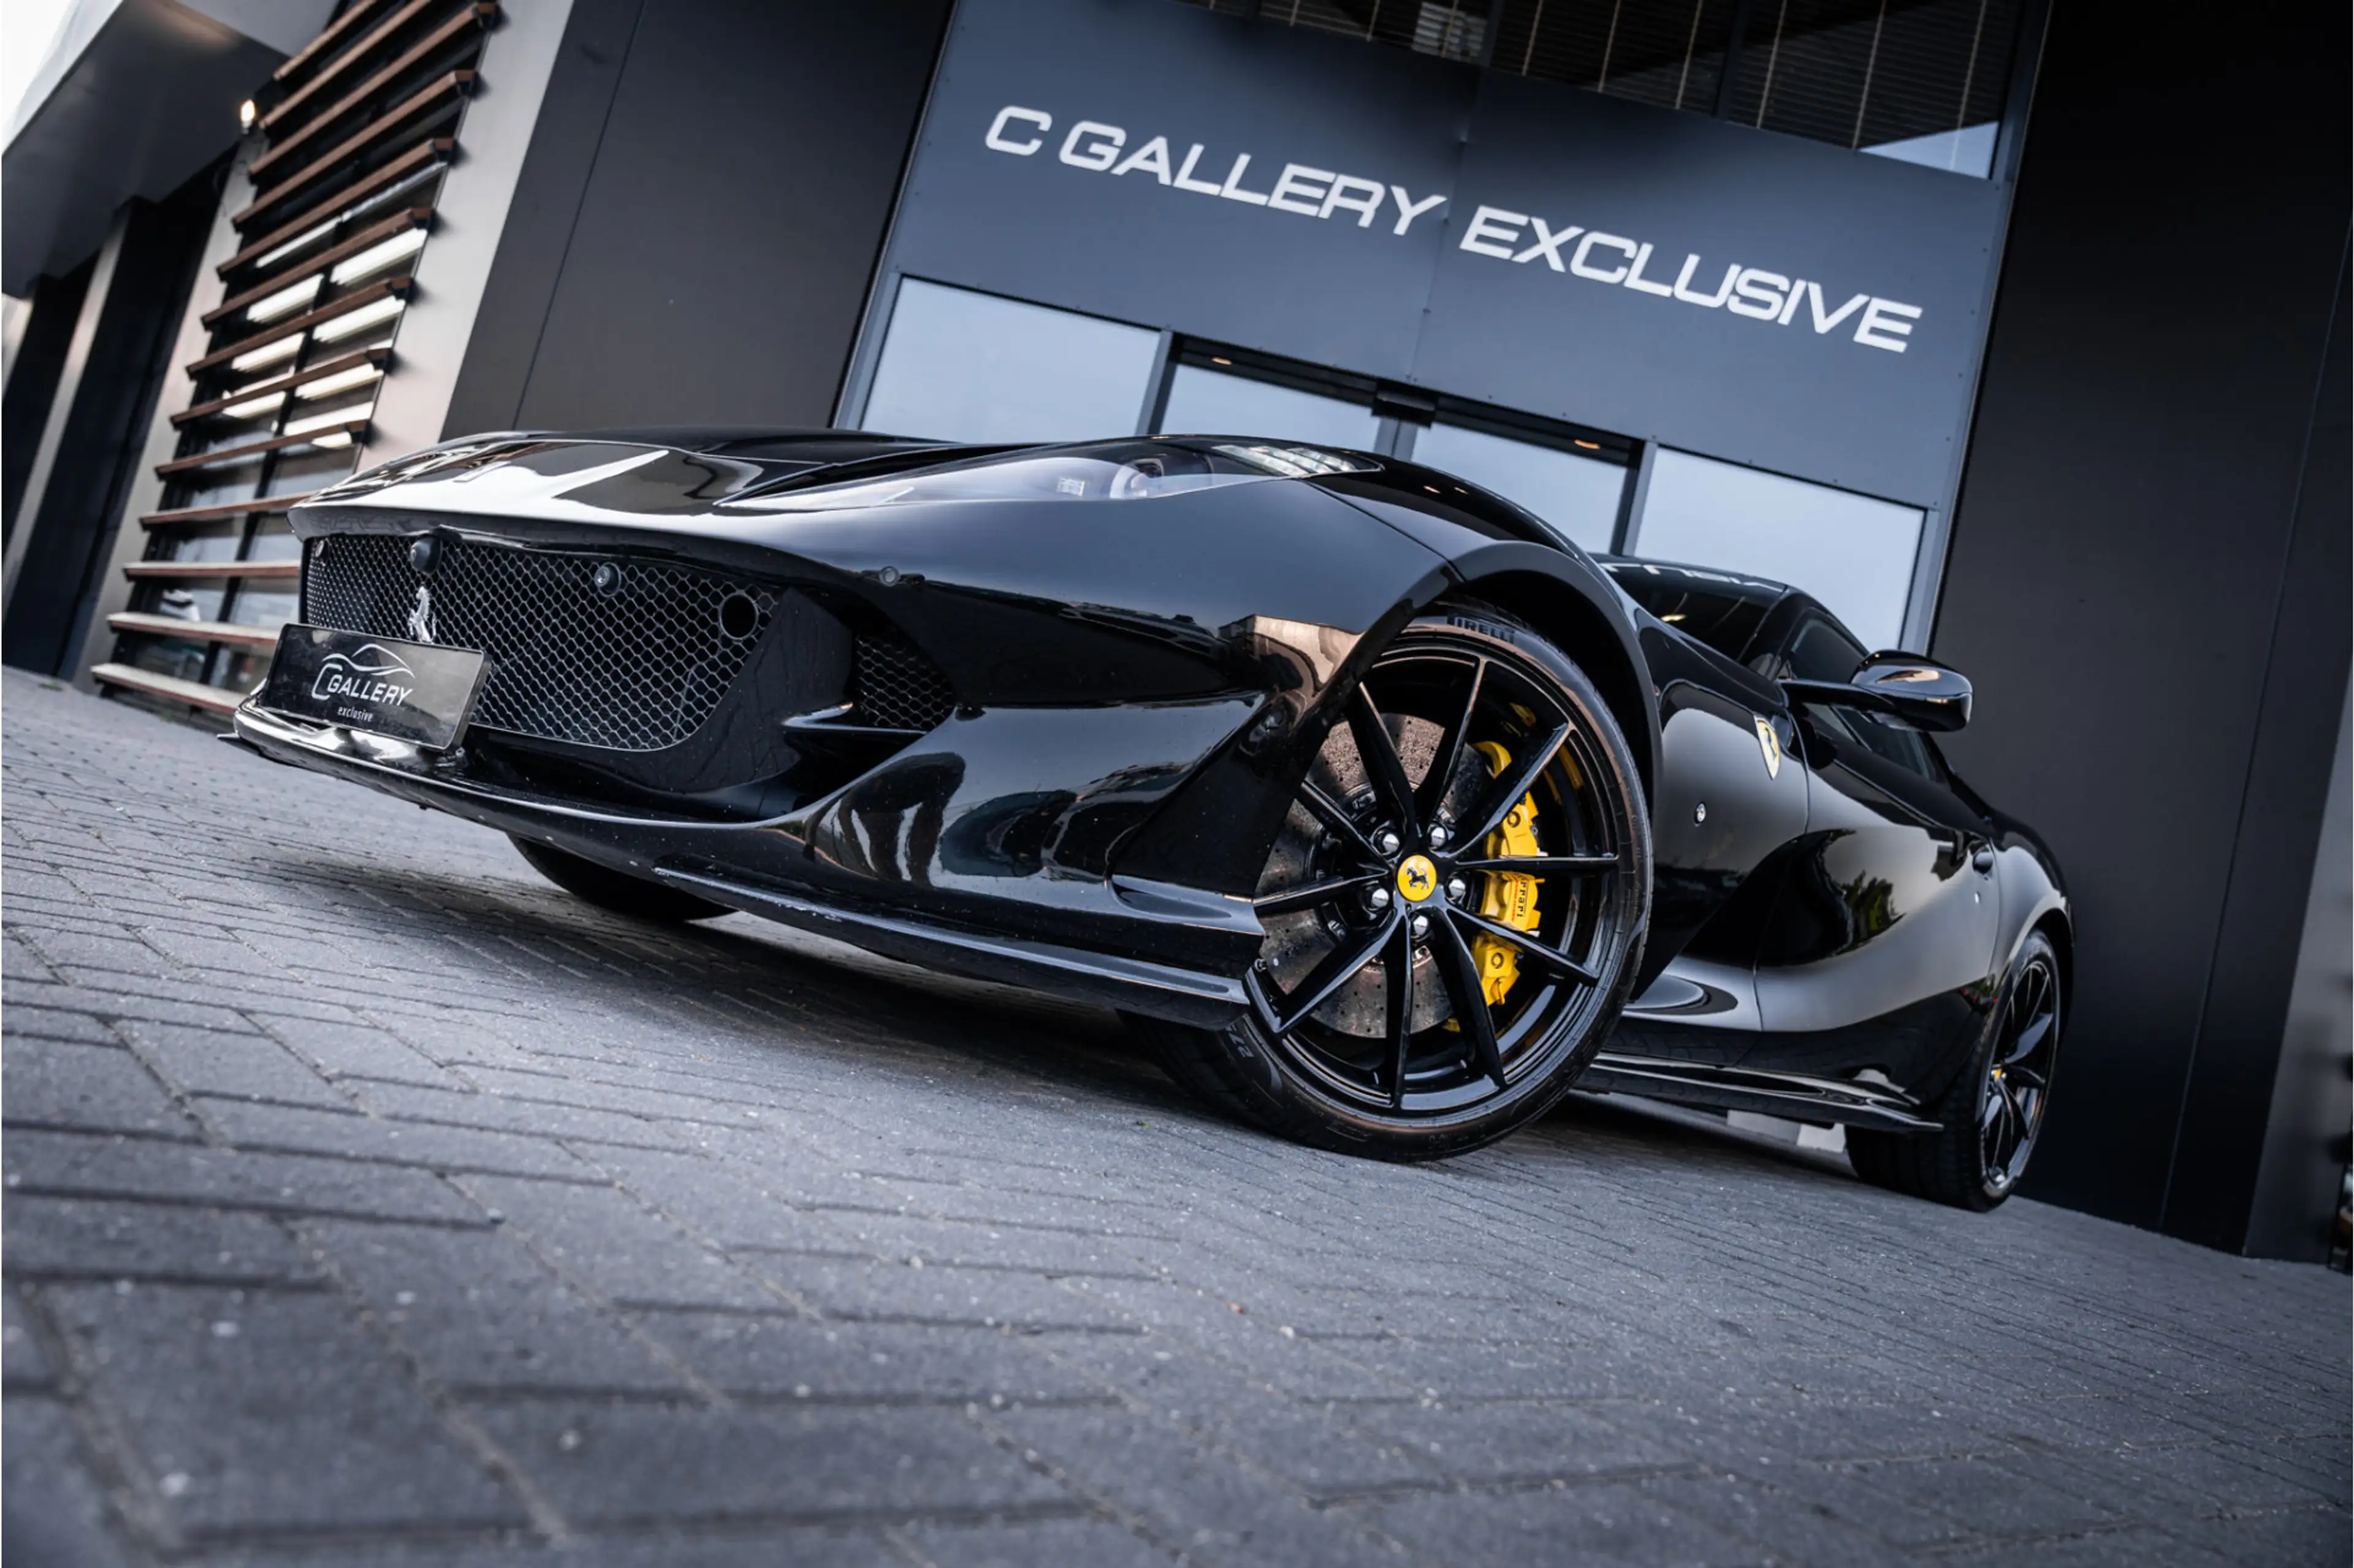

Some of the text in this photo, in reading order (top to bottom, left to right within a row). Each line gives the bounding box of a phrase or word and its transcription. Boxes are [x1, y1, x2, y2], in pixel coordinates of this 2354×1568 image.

[985, 105, 1923, 353] C GALLERY EXCLUSIVE
[338, 706, 373, 722] exclusive
